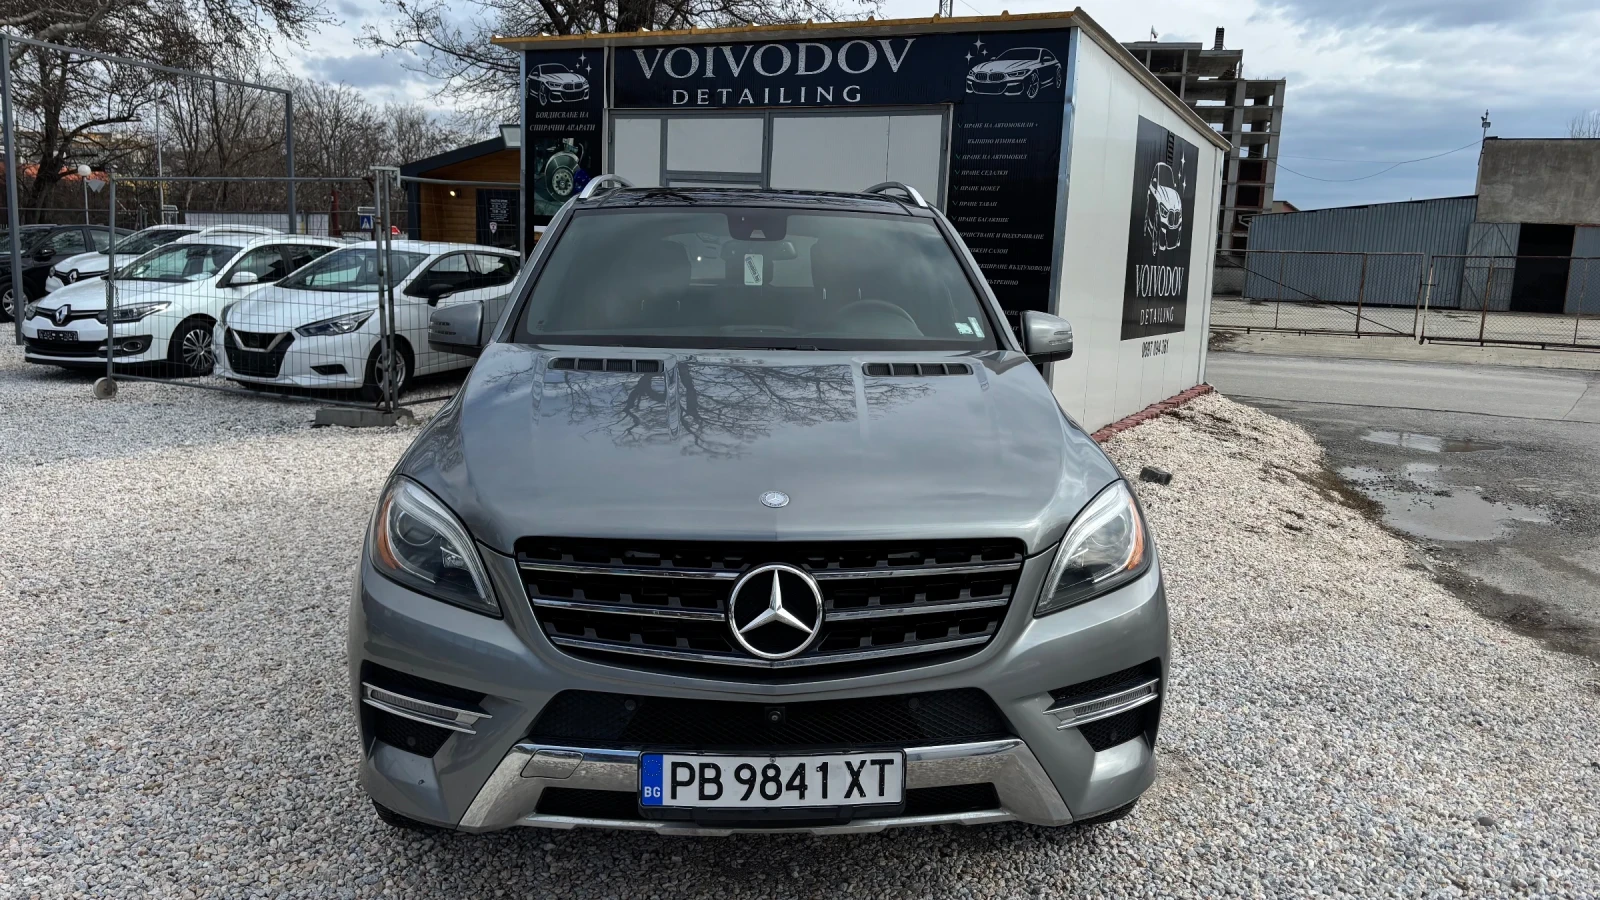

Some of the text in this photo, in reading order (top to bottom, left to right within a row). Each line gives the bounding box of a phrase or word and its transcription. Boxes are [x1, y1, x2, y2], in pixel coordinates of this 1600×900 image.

[632, 38, 916, 79] VOIVODOV
[672, 85, 861, 105] DETAILING
[535, 111, 578, 119] БОЯДИСВАНЕ
[1135, 264, 1184, 298] VOIVODOV
[1140, 306, 1174, 326] DETAILING
[670, 758, 895, 801] PB 9841 XT
[643, 786, 661, 798] BG
